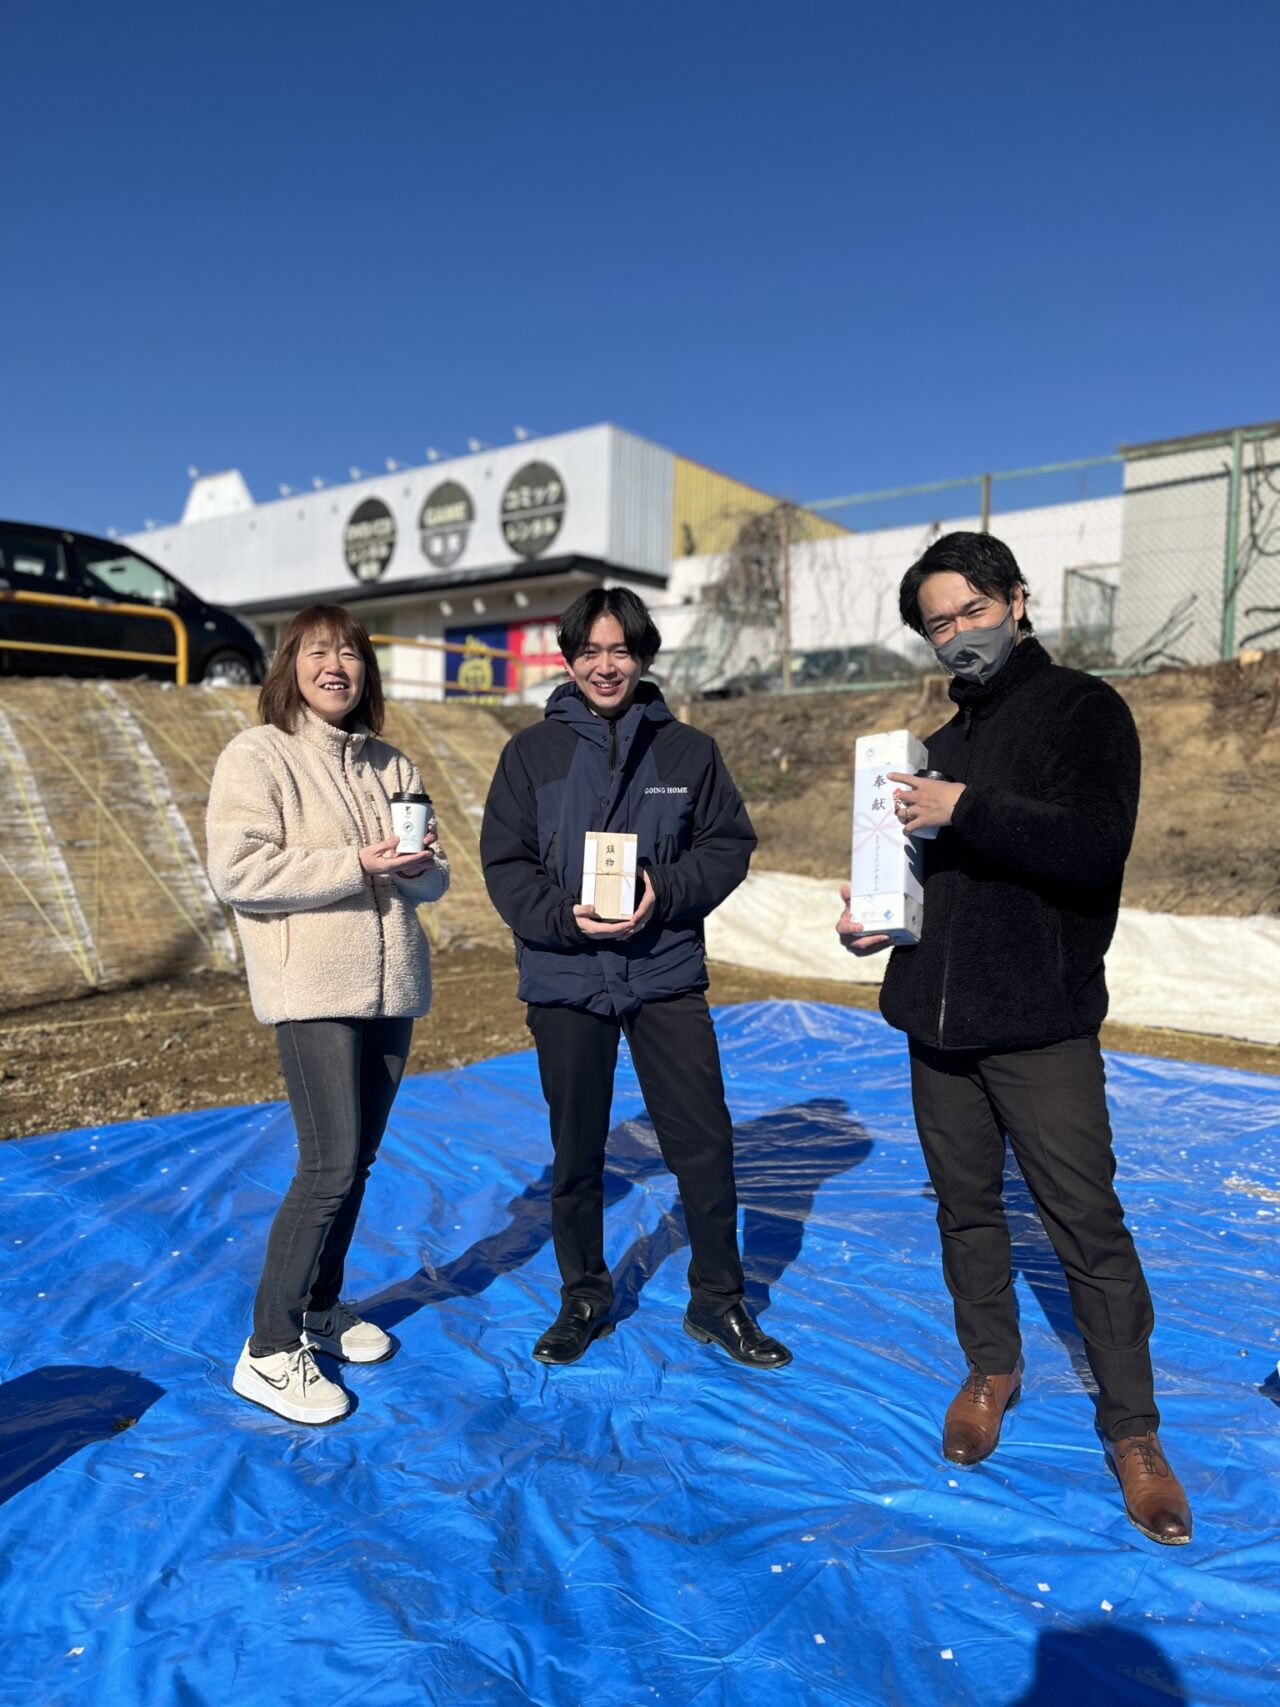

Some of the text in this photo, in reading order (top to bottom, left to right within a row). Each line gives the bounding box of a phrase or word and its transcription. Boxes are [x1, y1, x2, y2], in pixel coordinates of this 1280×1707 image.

[505, 480, 560, 511] コミック
[424, 502, 467, 525] GAME
[871, 774, 887, 811] 奉献
